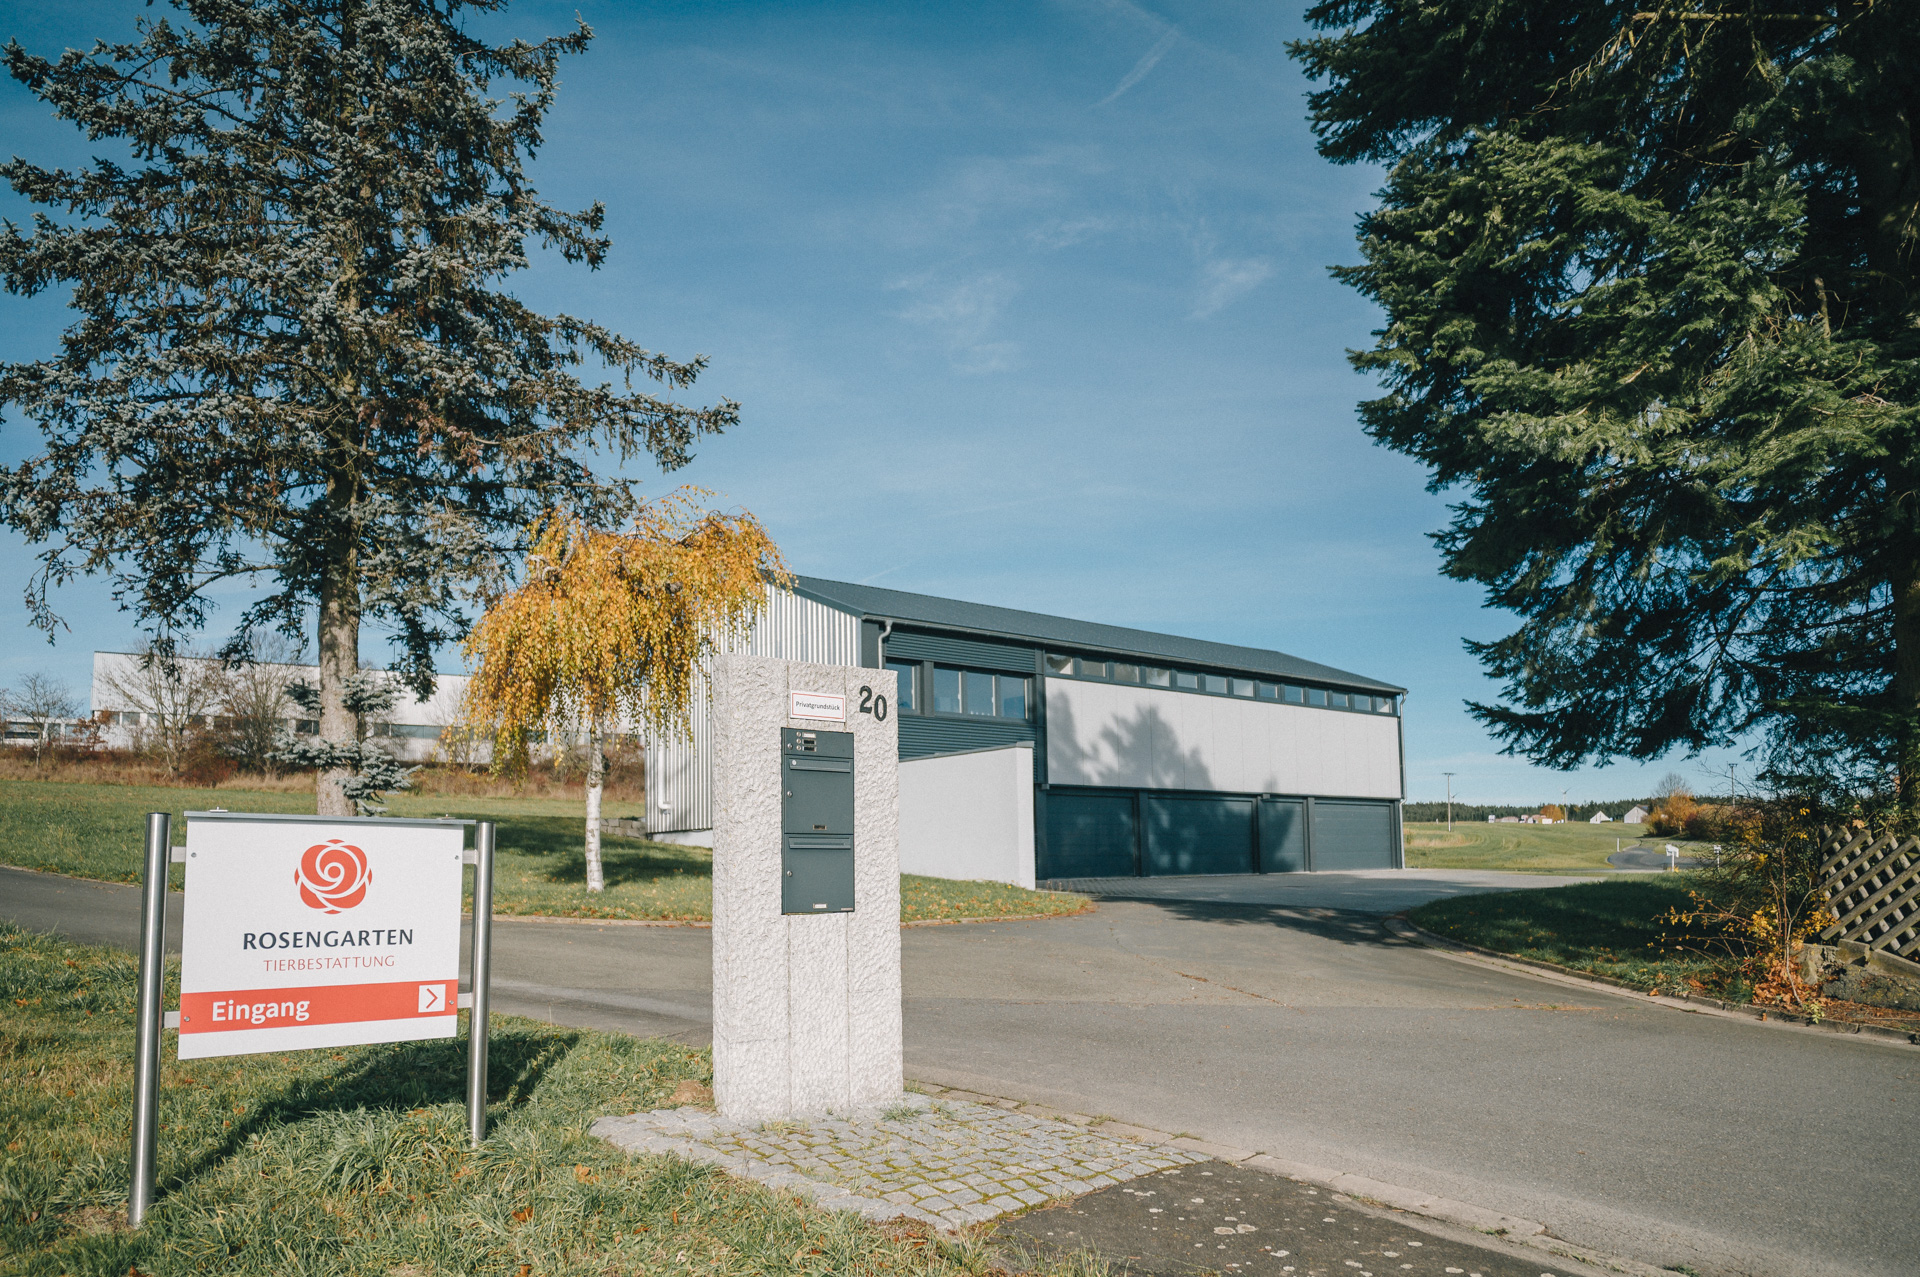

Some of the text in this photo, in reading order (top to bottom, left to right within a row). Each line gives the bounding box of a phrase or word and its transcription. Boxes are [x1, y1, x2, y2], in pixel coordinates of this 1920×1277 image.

[795, 701, 840, 711] Privatgrundstück
[860, 685, 887, 721] 20
[243, 929, 413, 950] ROSENGARTEN
[263, 955, 395, 972] TIERBESTATTUNG
[212, 1000, 310, 1024] Eingang
